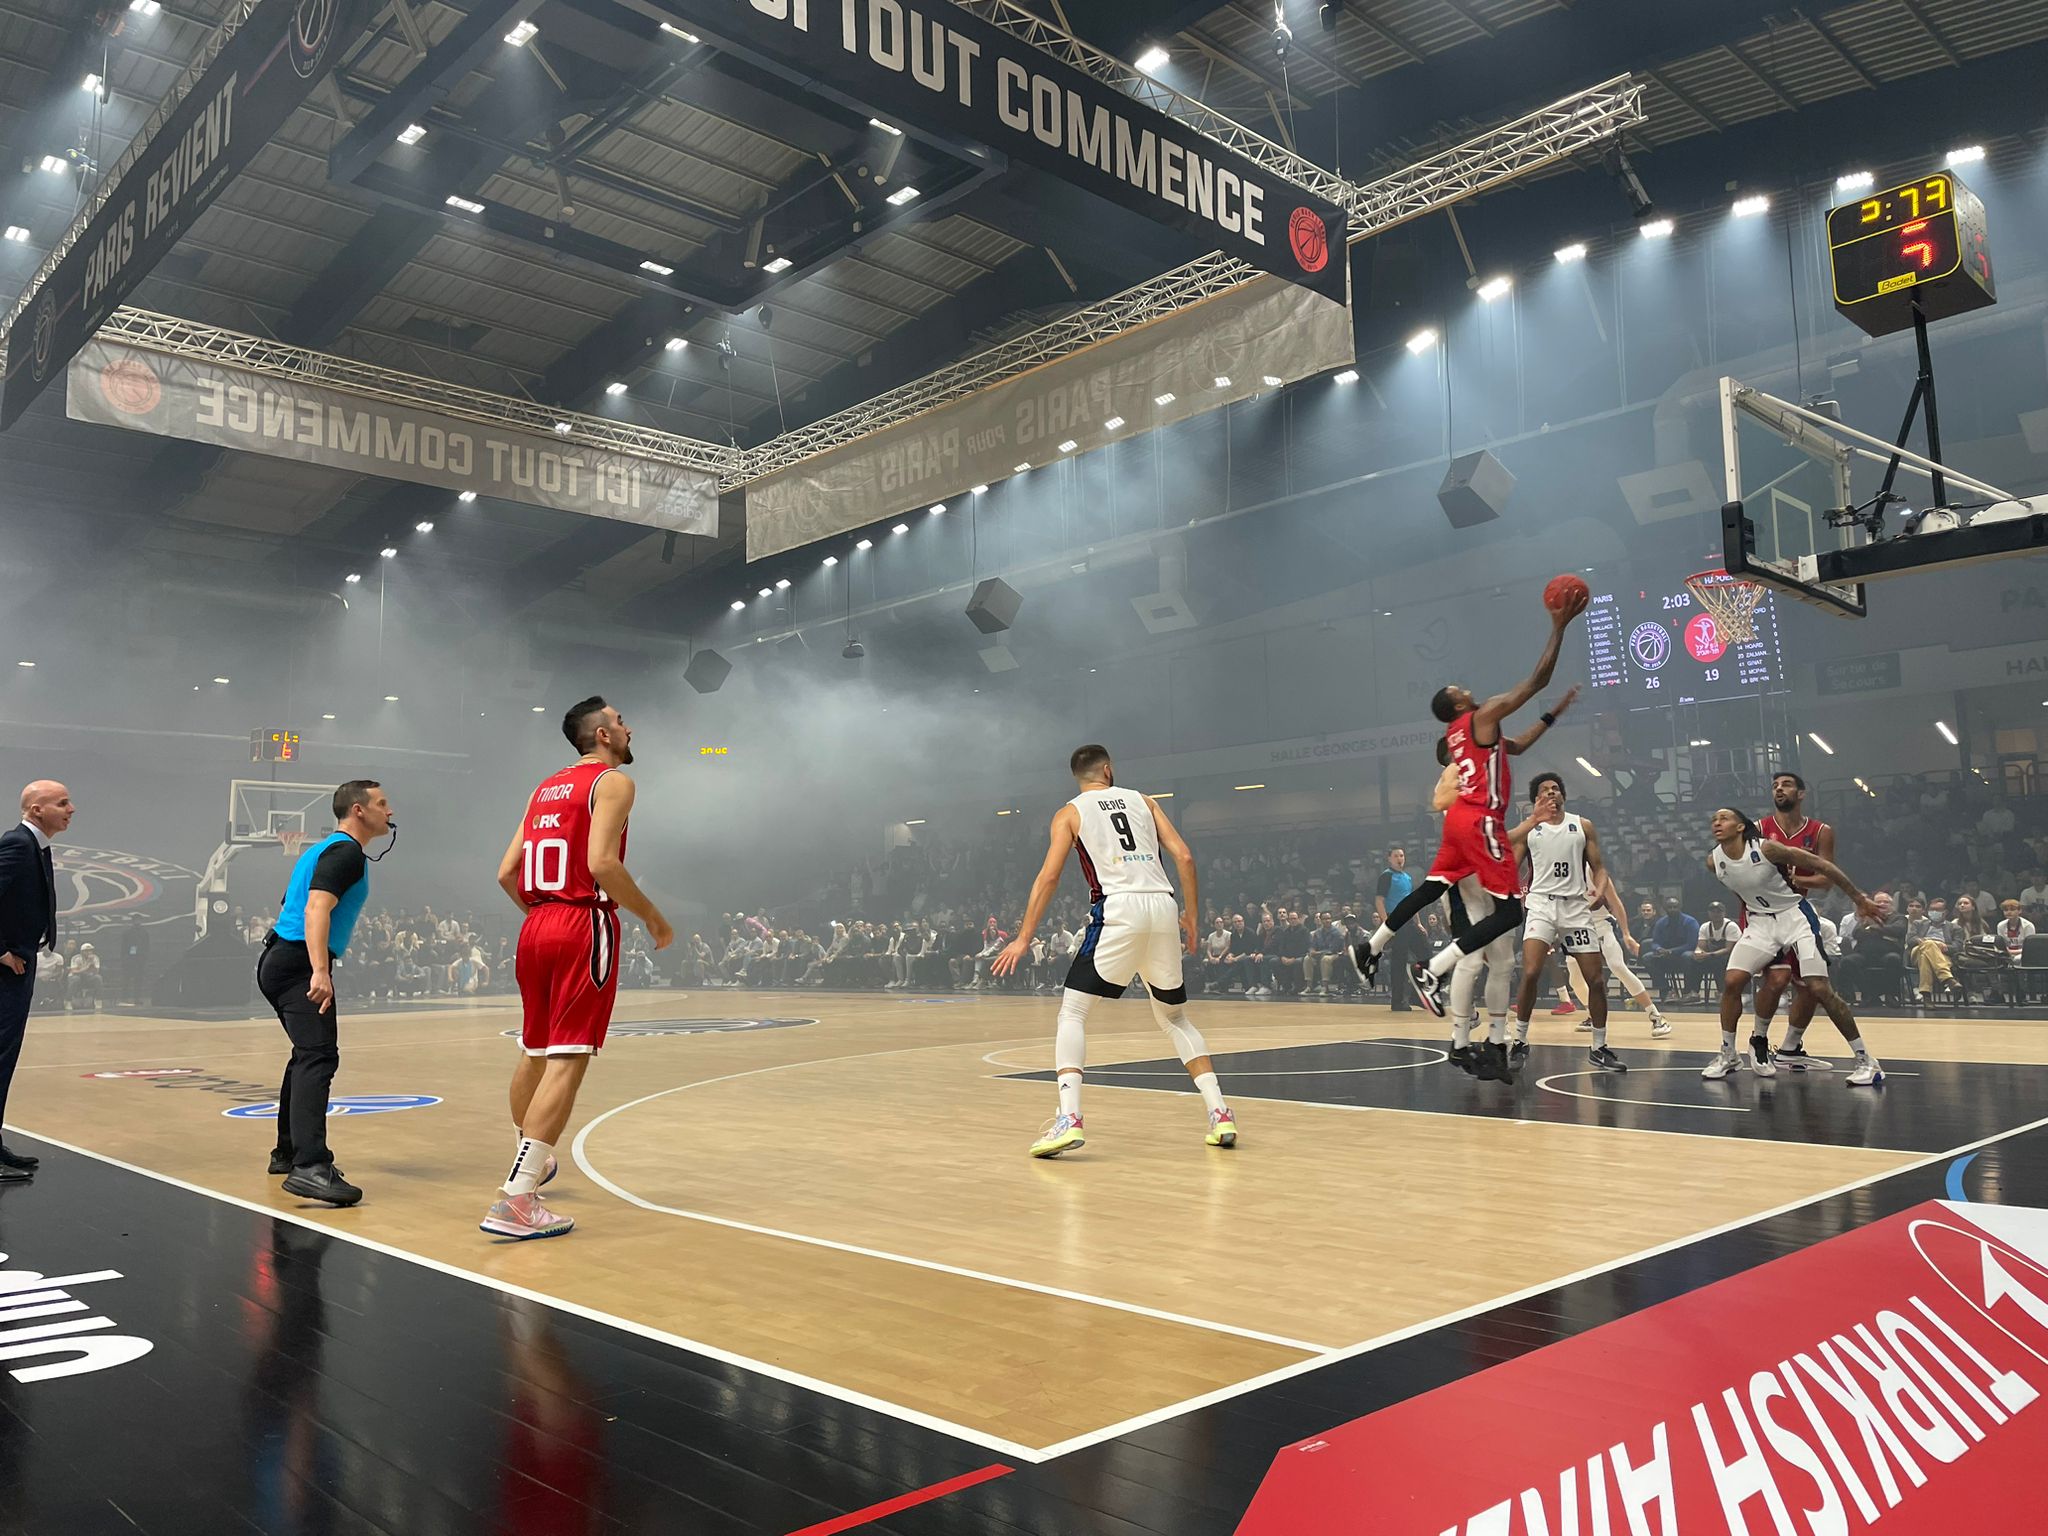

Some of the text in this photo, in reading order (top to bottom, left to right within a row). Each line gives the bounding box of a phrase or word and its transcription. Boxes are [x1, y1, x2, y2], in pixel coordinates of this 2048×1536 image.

[997, 57, 1265, 246] COMMENCE
[82, 200, 136, 311] PARIS
[144, 71, 238, 240] REVIENT
[1881, 275, 1914, 291] Bodet
[1593, 594, 1614, 605] PARIS
[1662, 593, 1691, 610] 2:03
[1645, 676, 1660, 689] 26
[1704, 668, 1720, 682] 19
[1270, 747, 1313, 763] HALLE
[1313, 738, 1377, 756] GEORGES
[537, 783, 574, 803] TIMOR
[1110, 812, 1137, 851] 9
[522, 838, 568, 892] 10
[1554, 862, 1569, 878] 33
[1755, 896, 1770, 908] 0
[1574, 929, 1591, 946] 33
[1691, 1295, 2041, 1536] TURKISH
